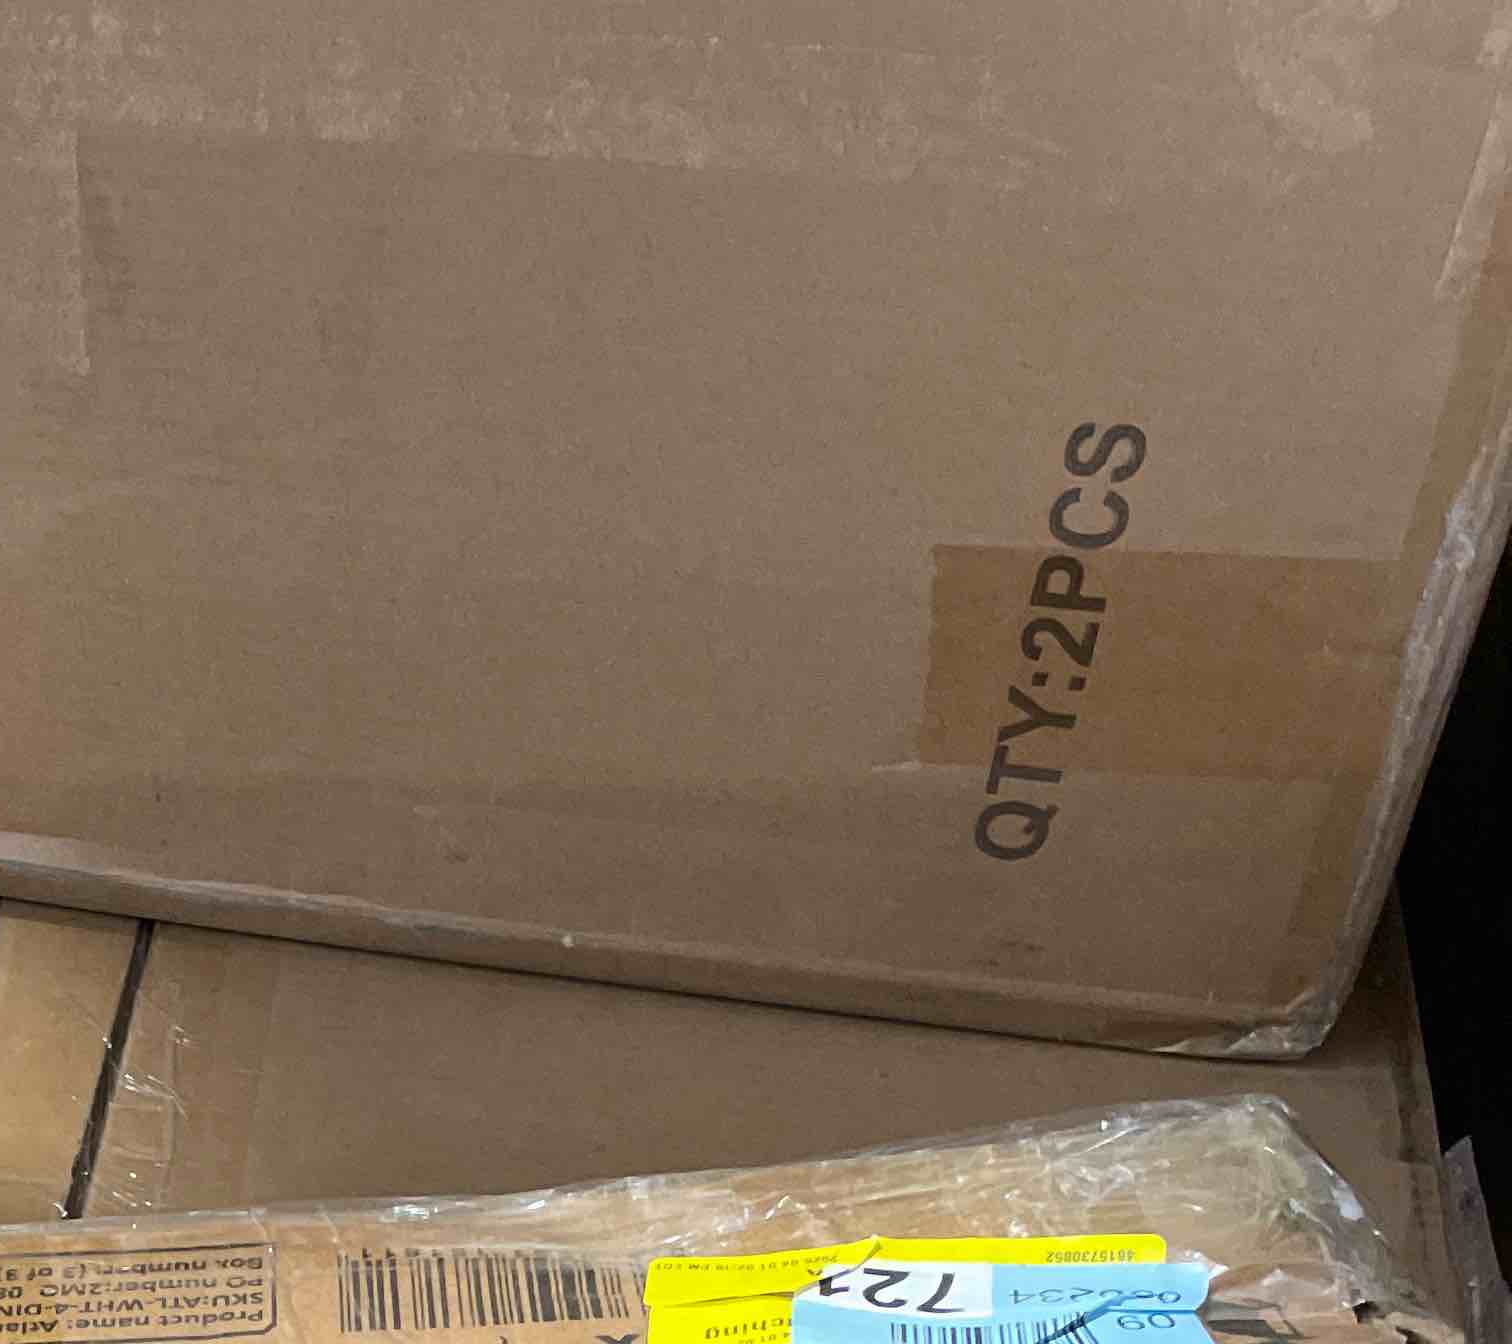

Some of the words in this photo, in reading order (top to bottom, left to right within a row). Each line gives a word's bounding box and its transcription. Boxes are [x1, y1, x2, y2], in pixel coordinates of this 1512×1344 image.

[975, 422, 1147, 861] QTY:2PCS
[65, 1313, 149, 1331] name:
[159, 1307, 263, 1328] Product
